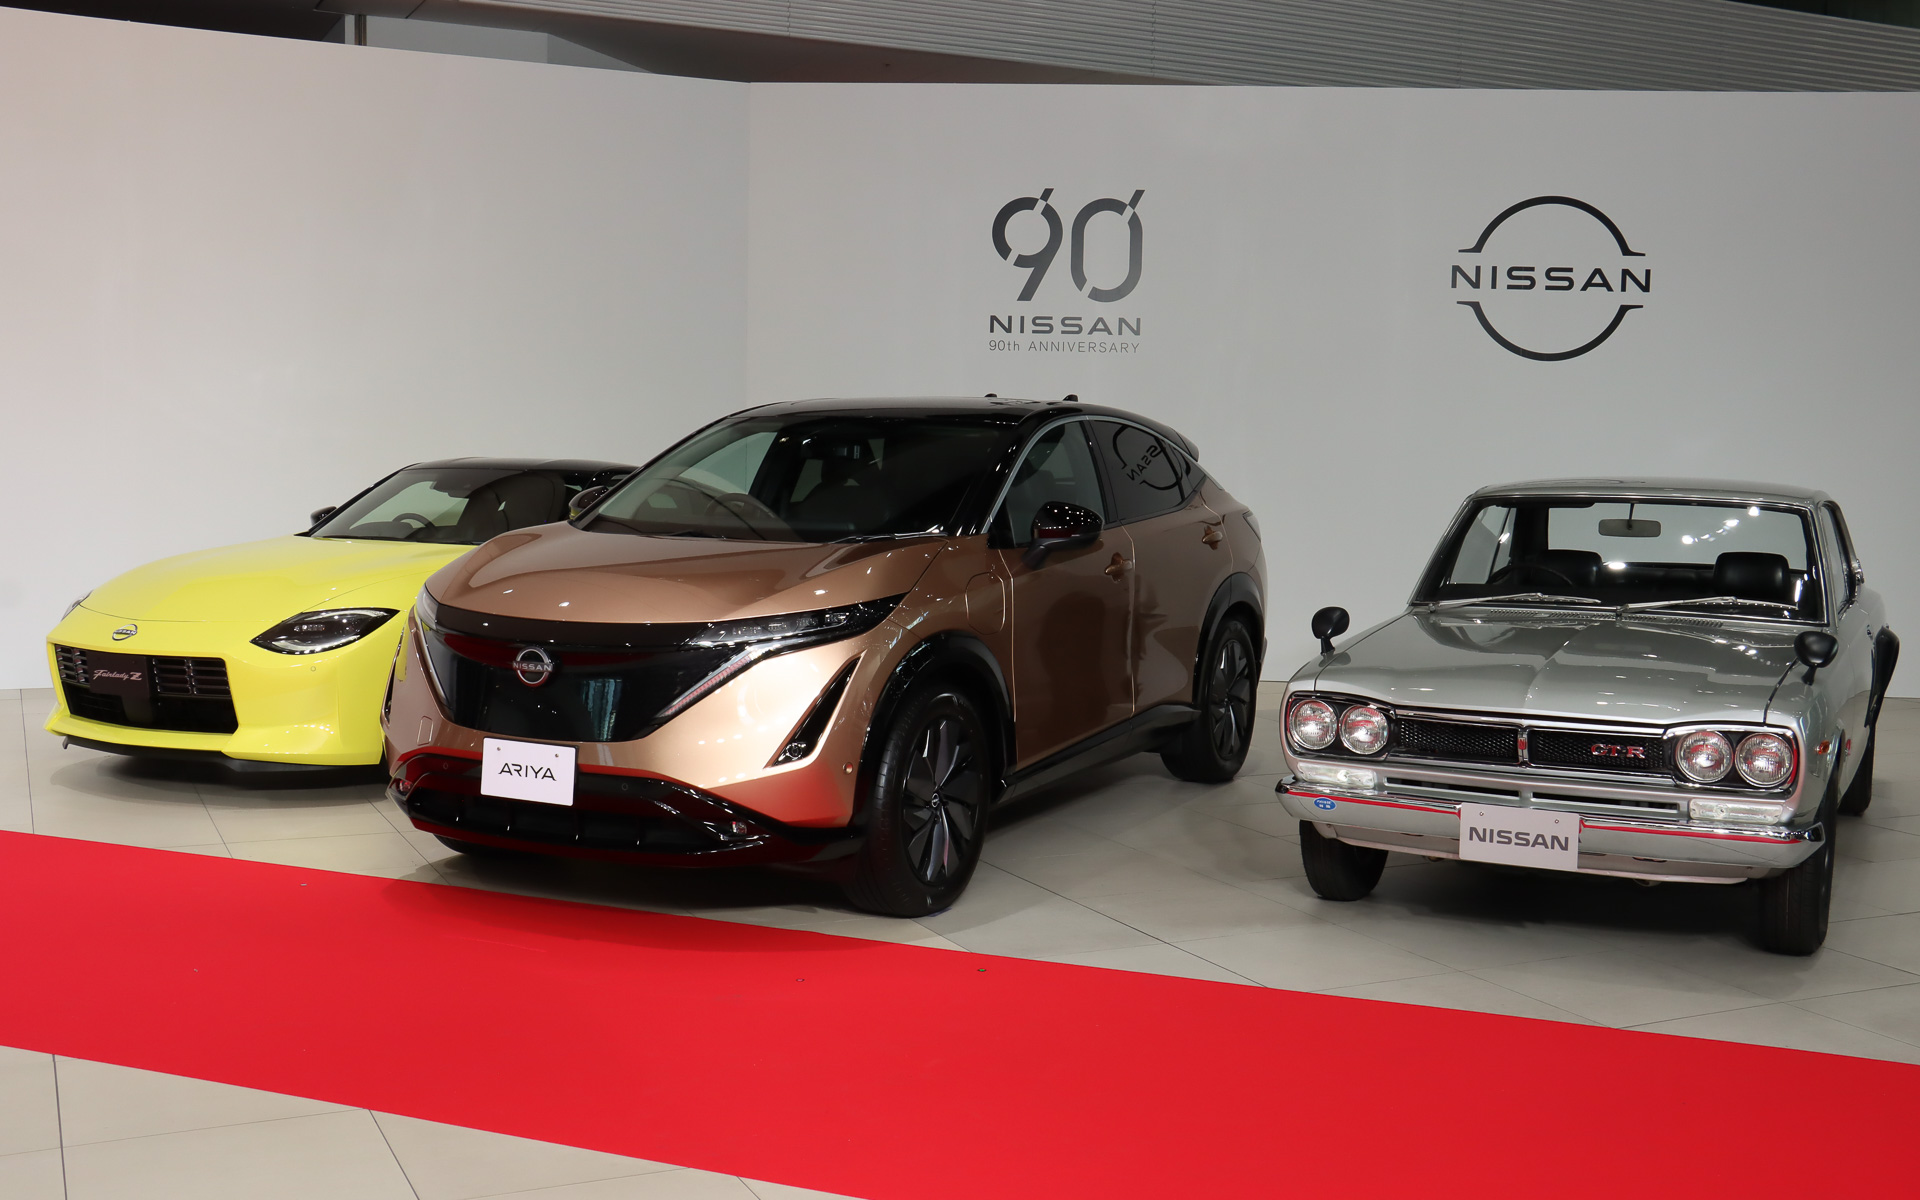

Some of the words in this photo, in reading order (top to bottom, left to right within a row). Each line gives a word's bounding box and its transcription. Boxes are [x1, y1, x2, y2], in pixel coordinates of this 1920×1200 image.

[991, 187, 1146, 303] 90
[1451, 264, 1652, 293] NISSAN
[989, 314, 1142, 336] NISSAN
[988, 339, 1021, 352] 90th
[1028, 341, 1141, 354] ANNIVERSARY
[92, 669, 130, 681] Fairlady
[130, 671, 143, 681] Z
[512, 661, 553, 673] NISSAN
[498, 762, 557, 782] ARIYA
[1468, 826, 1569, 852] NISSAN
